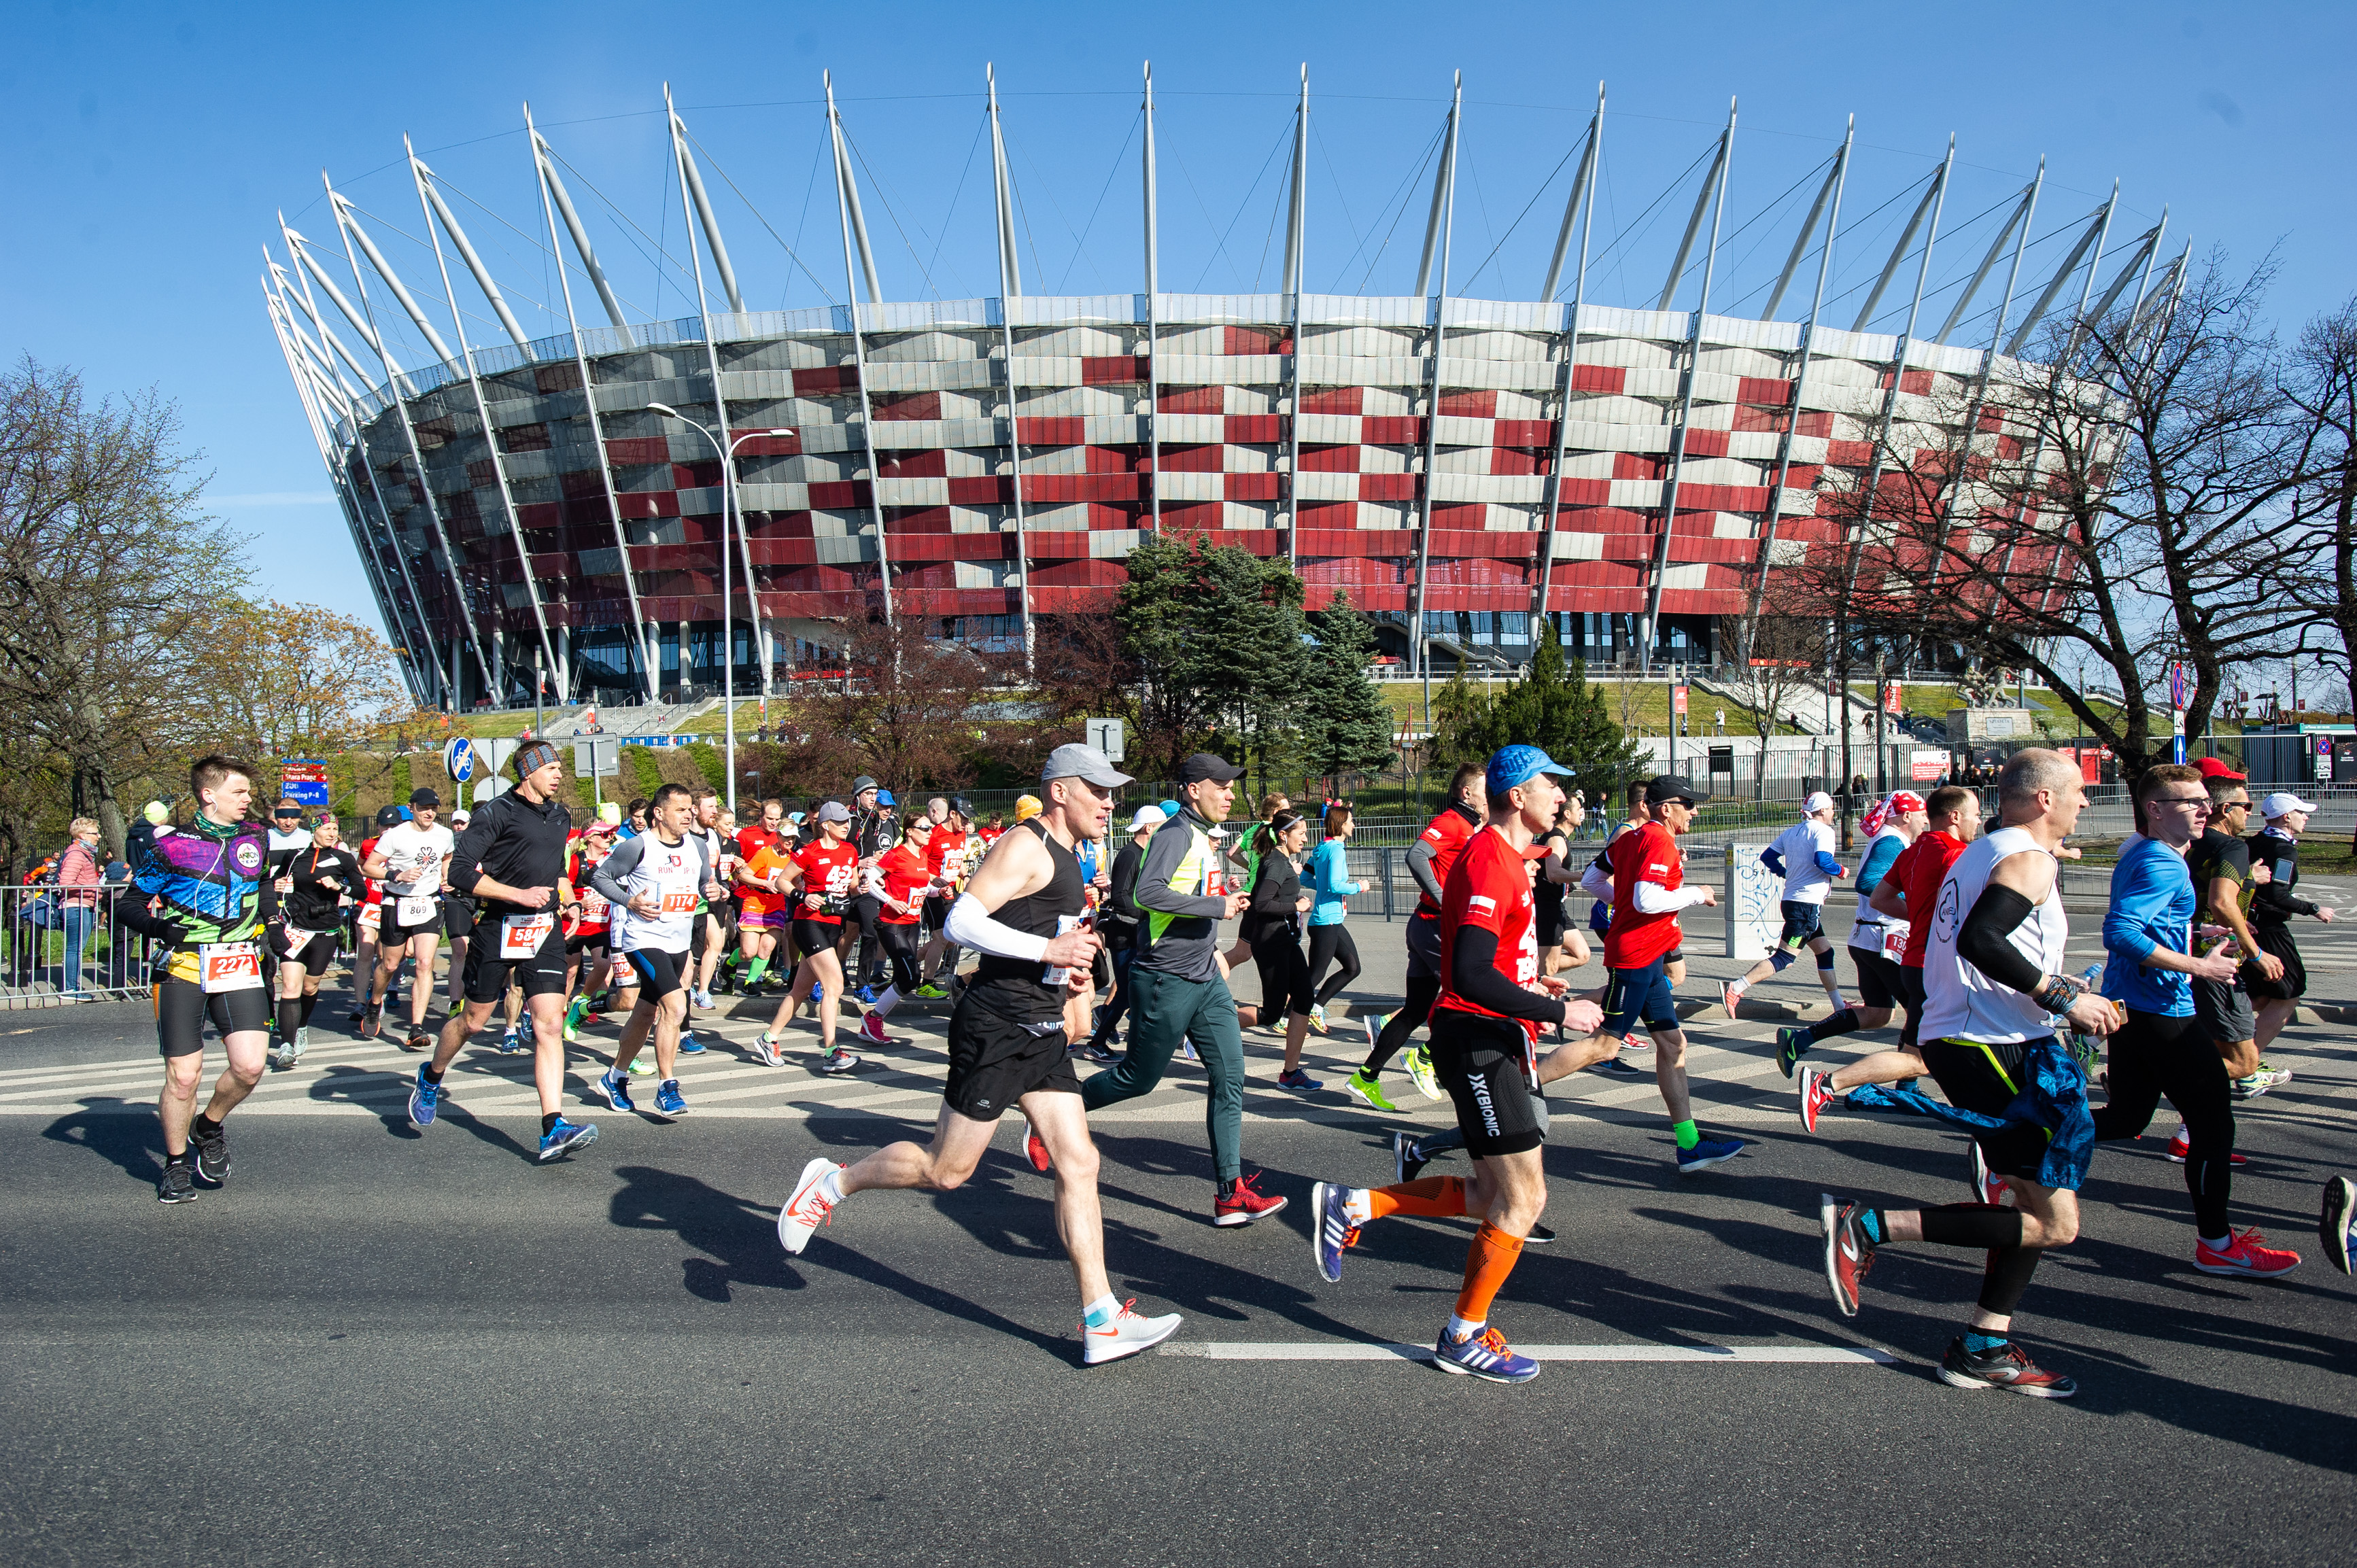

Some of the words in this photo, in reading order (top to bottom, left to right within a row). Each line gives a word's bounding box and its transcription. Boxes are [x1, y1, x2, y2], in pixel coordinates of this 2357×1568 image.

[176, 832, 202, 840] deep
[670, 895, 694, 907] 1174
[410, 906, 427, 915] 809
[515, 927, 546, 941] 5840
[216, 956, 253, 973] 2271
